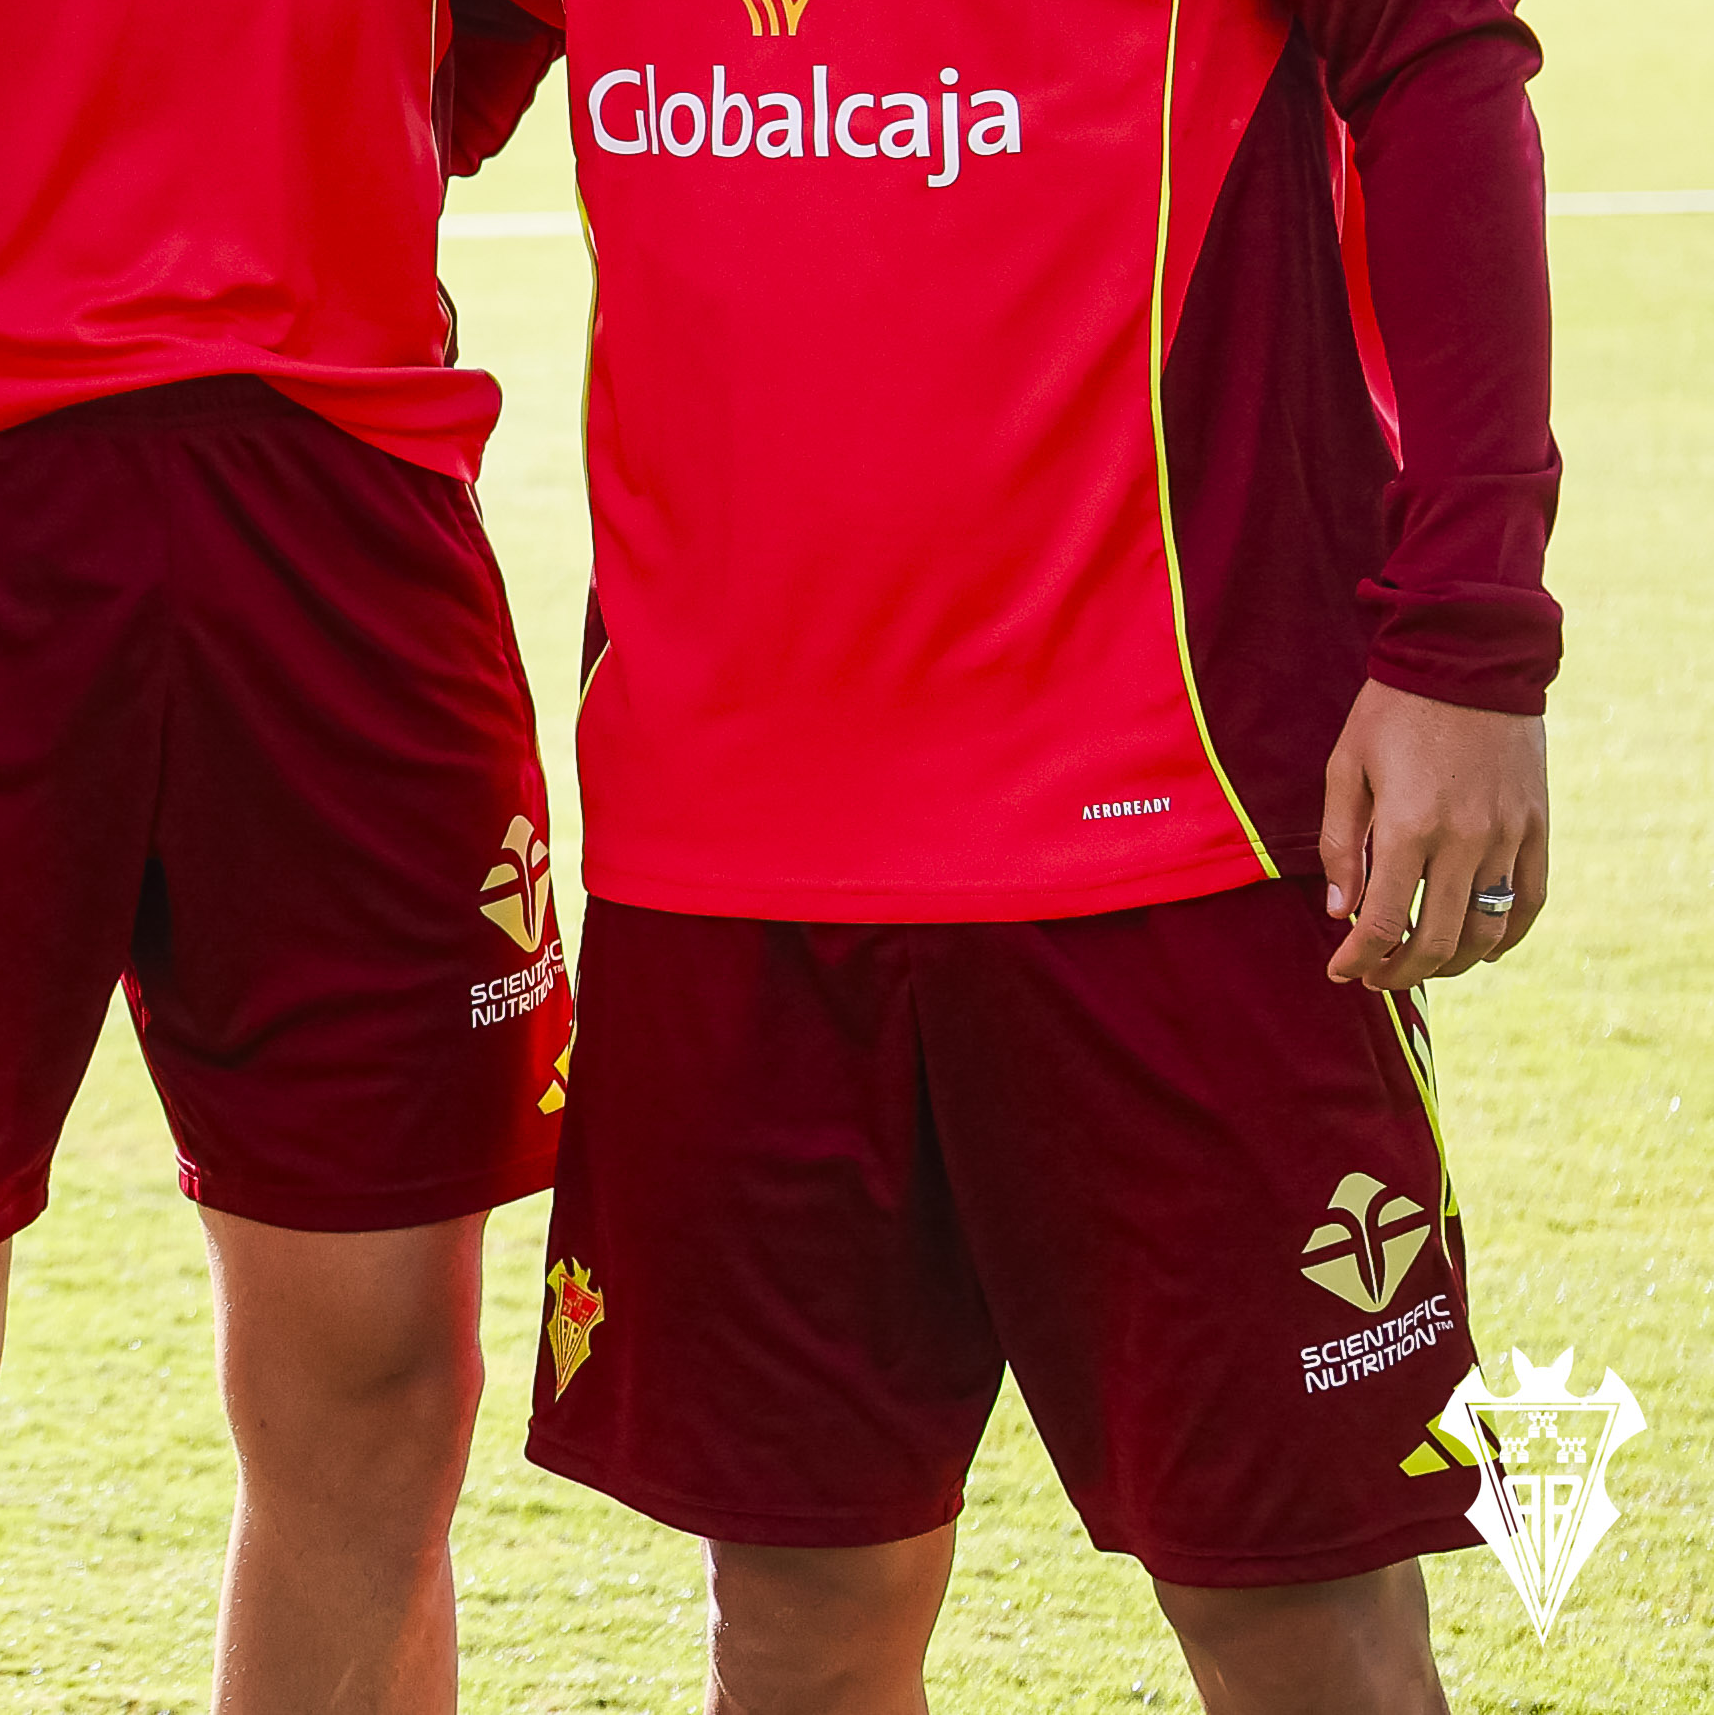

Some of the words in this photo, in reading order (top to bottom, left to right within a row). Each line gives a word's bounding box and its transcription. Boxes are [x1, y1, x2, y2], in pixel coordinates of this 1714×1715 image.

[587, 63, 1022, 188] Globalcaja
[1082, 796, 1171, 820] AEROREADY
[1300, 1294, 1451, 1370] SCIENTIFFIC
